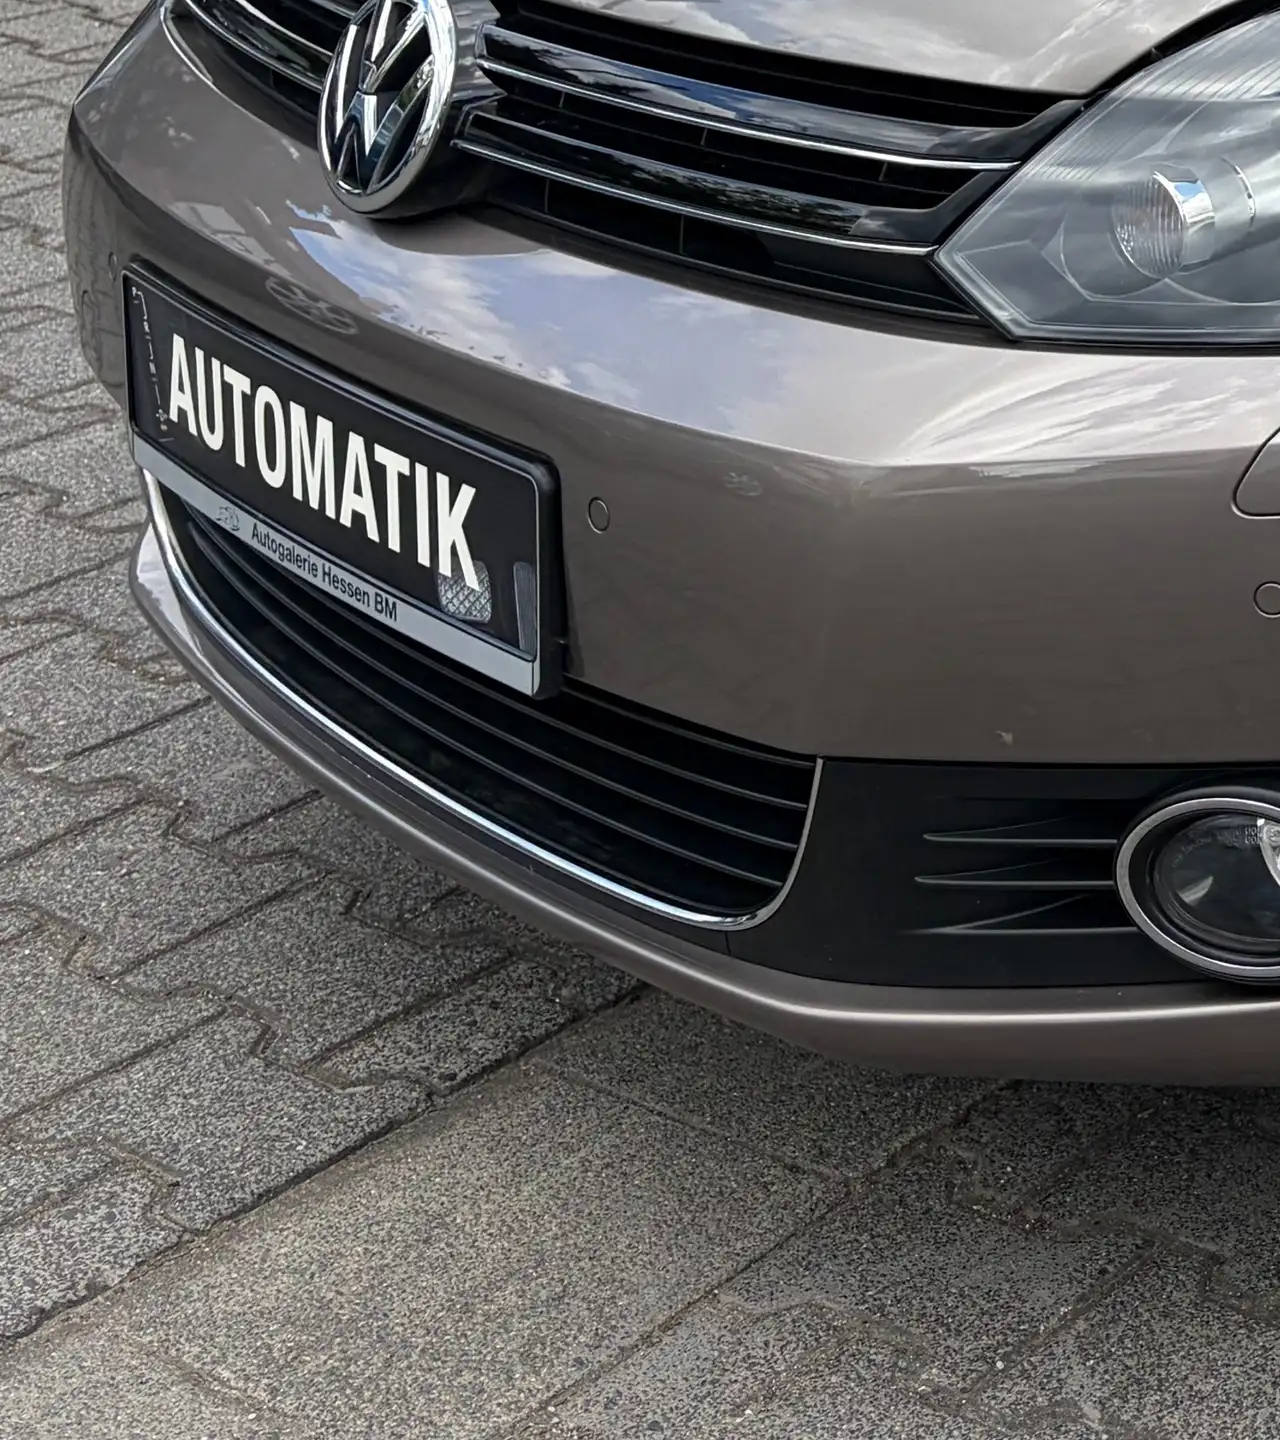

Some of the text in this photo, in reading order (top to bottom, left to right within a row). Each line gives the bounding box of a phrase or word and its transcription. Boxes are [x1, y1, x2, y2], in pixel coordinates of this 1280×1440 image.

[168, 332, 479, 591] AUTOMATIK
[251, 522, 398, 622] Autogalerie Hessen BM
